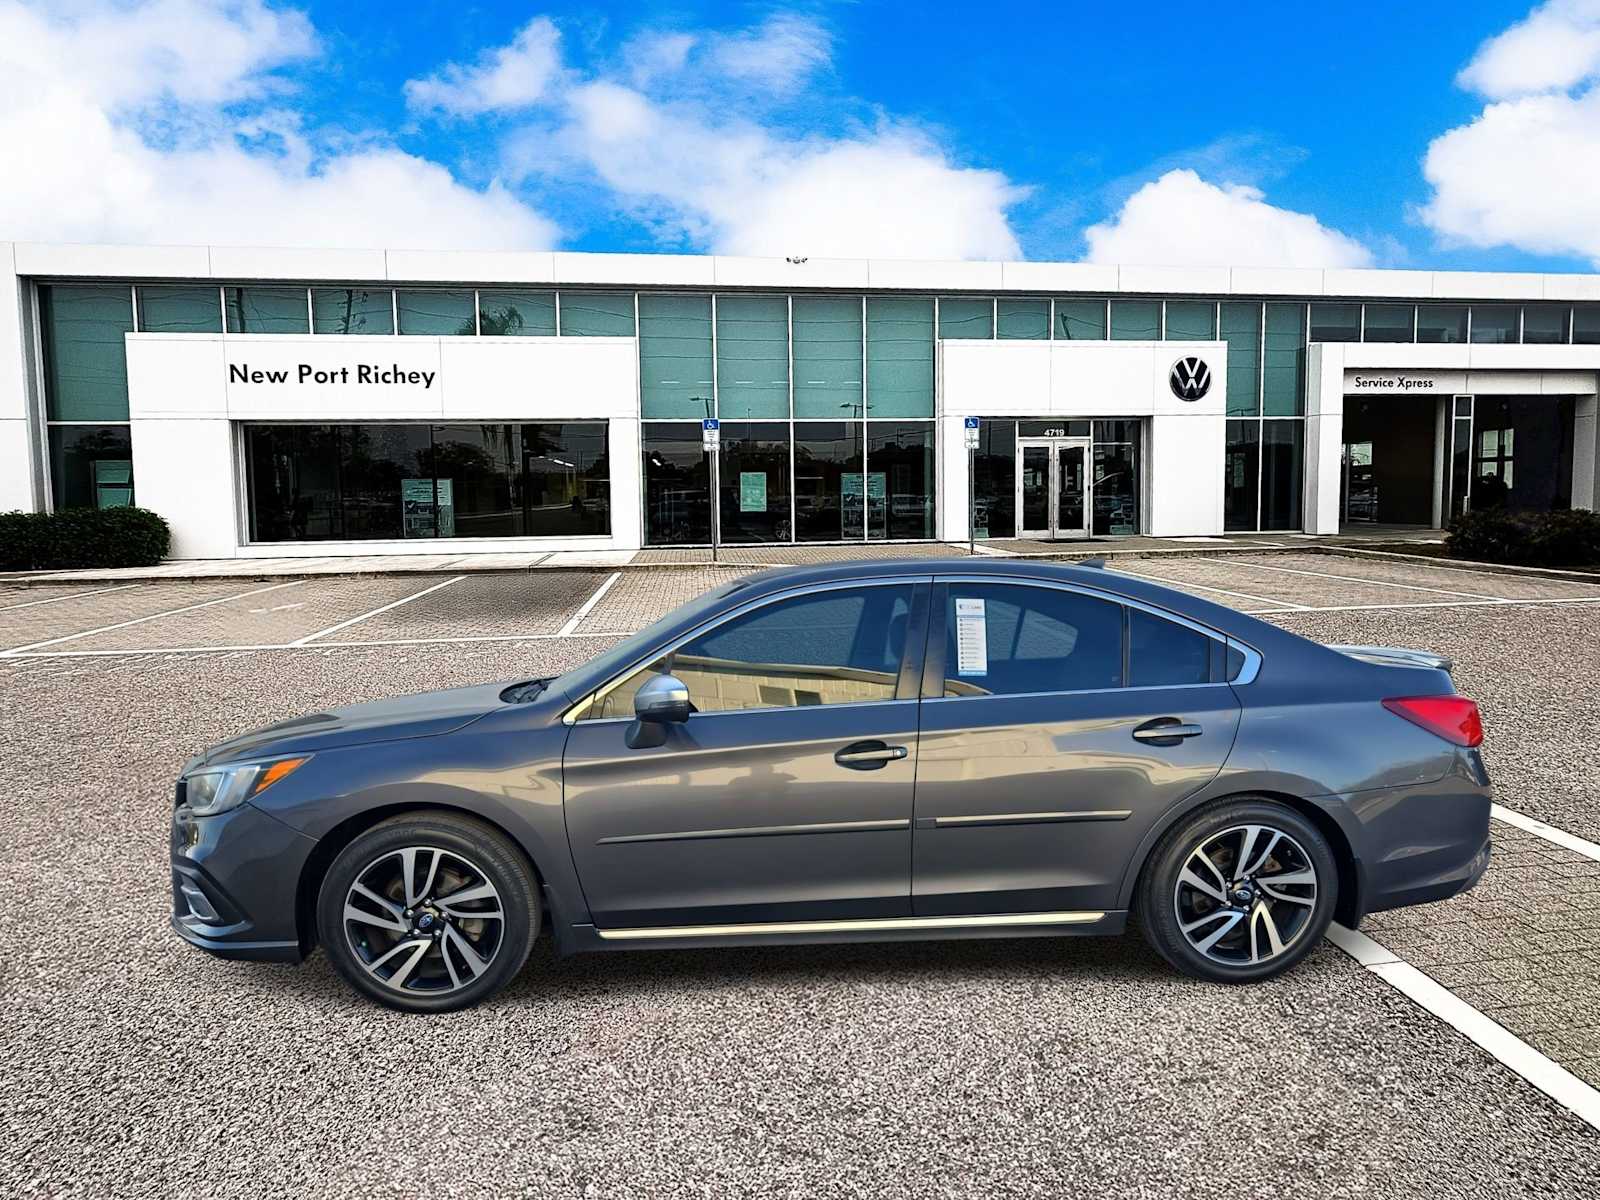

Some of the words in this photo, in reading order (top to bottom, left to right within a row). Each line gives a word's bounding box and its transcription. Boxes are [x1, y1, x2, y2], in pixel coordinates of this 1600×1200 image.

[229, 364, 289, 384] New
[298, 364, 349, 384] Port
[357, 363, 436, 389] Richey
[1355, 376, 1394, 388] Service
[1397, 376, 1434, 391] Xpress
[1044, 428, 1065, 437] 4719
